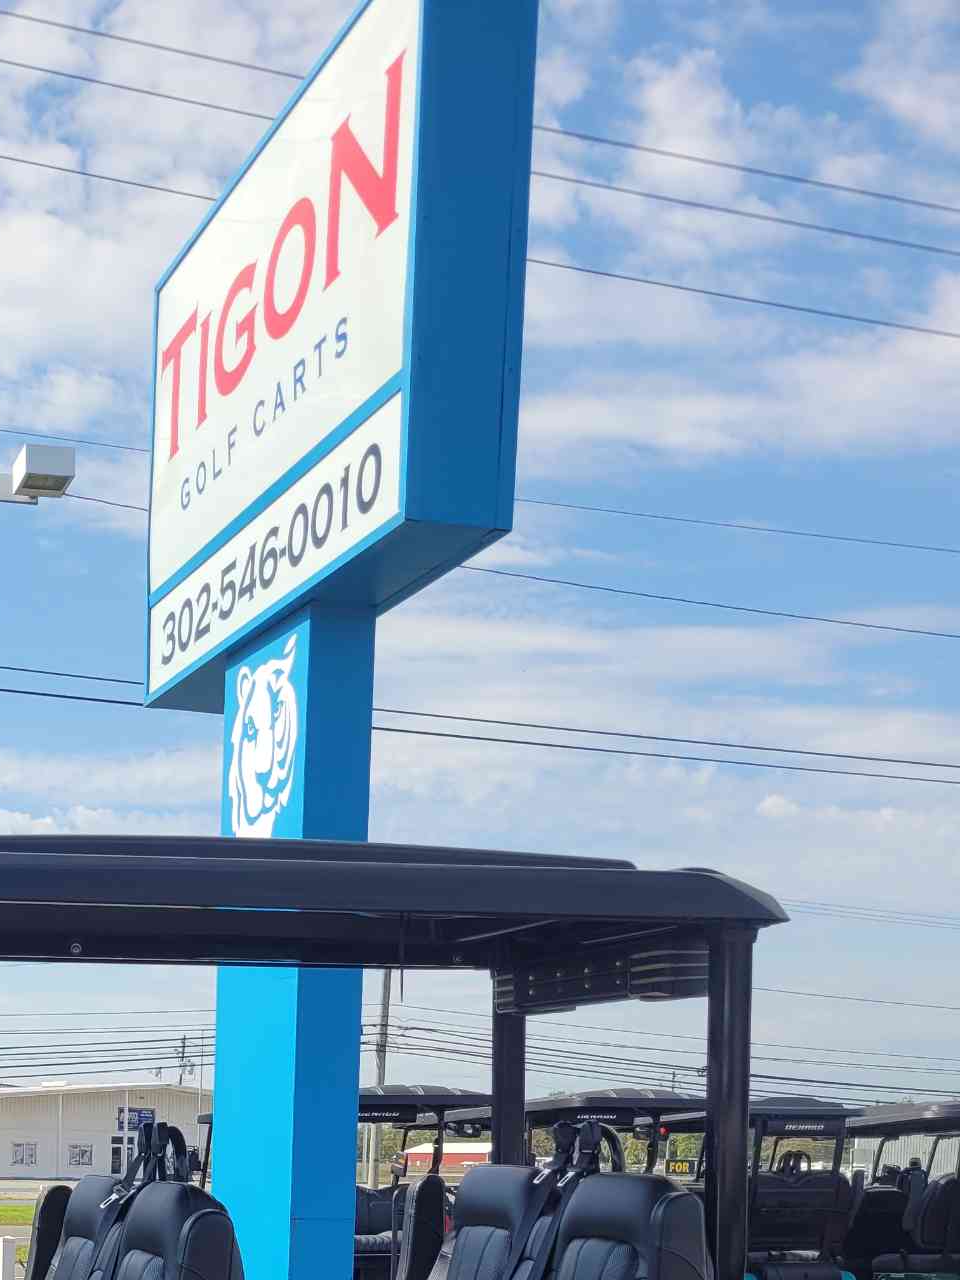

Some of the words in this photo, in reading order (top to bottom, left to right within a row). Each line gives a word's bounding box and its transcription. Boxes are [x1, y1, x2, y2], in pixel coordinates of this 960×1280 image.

[161, 47, 407, 463] TIGON
[180, 424, 238, 511] GOLF
[253, 316, 349, 438] CARTS
[161, 443, 383, 666] 302-546-0010
[669, 1162, 690, 1174] FOR
